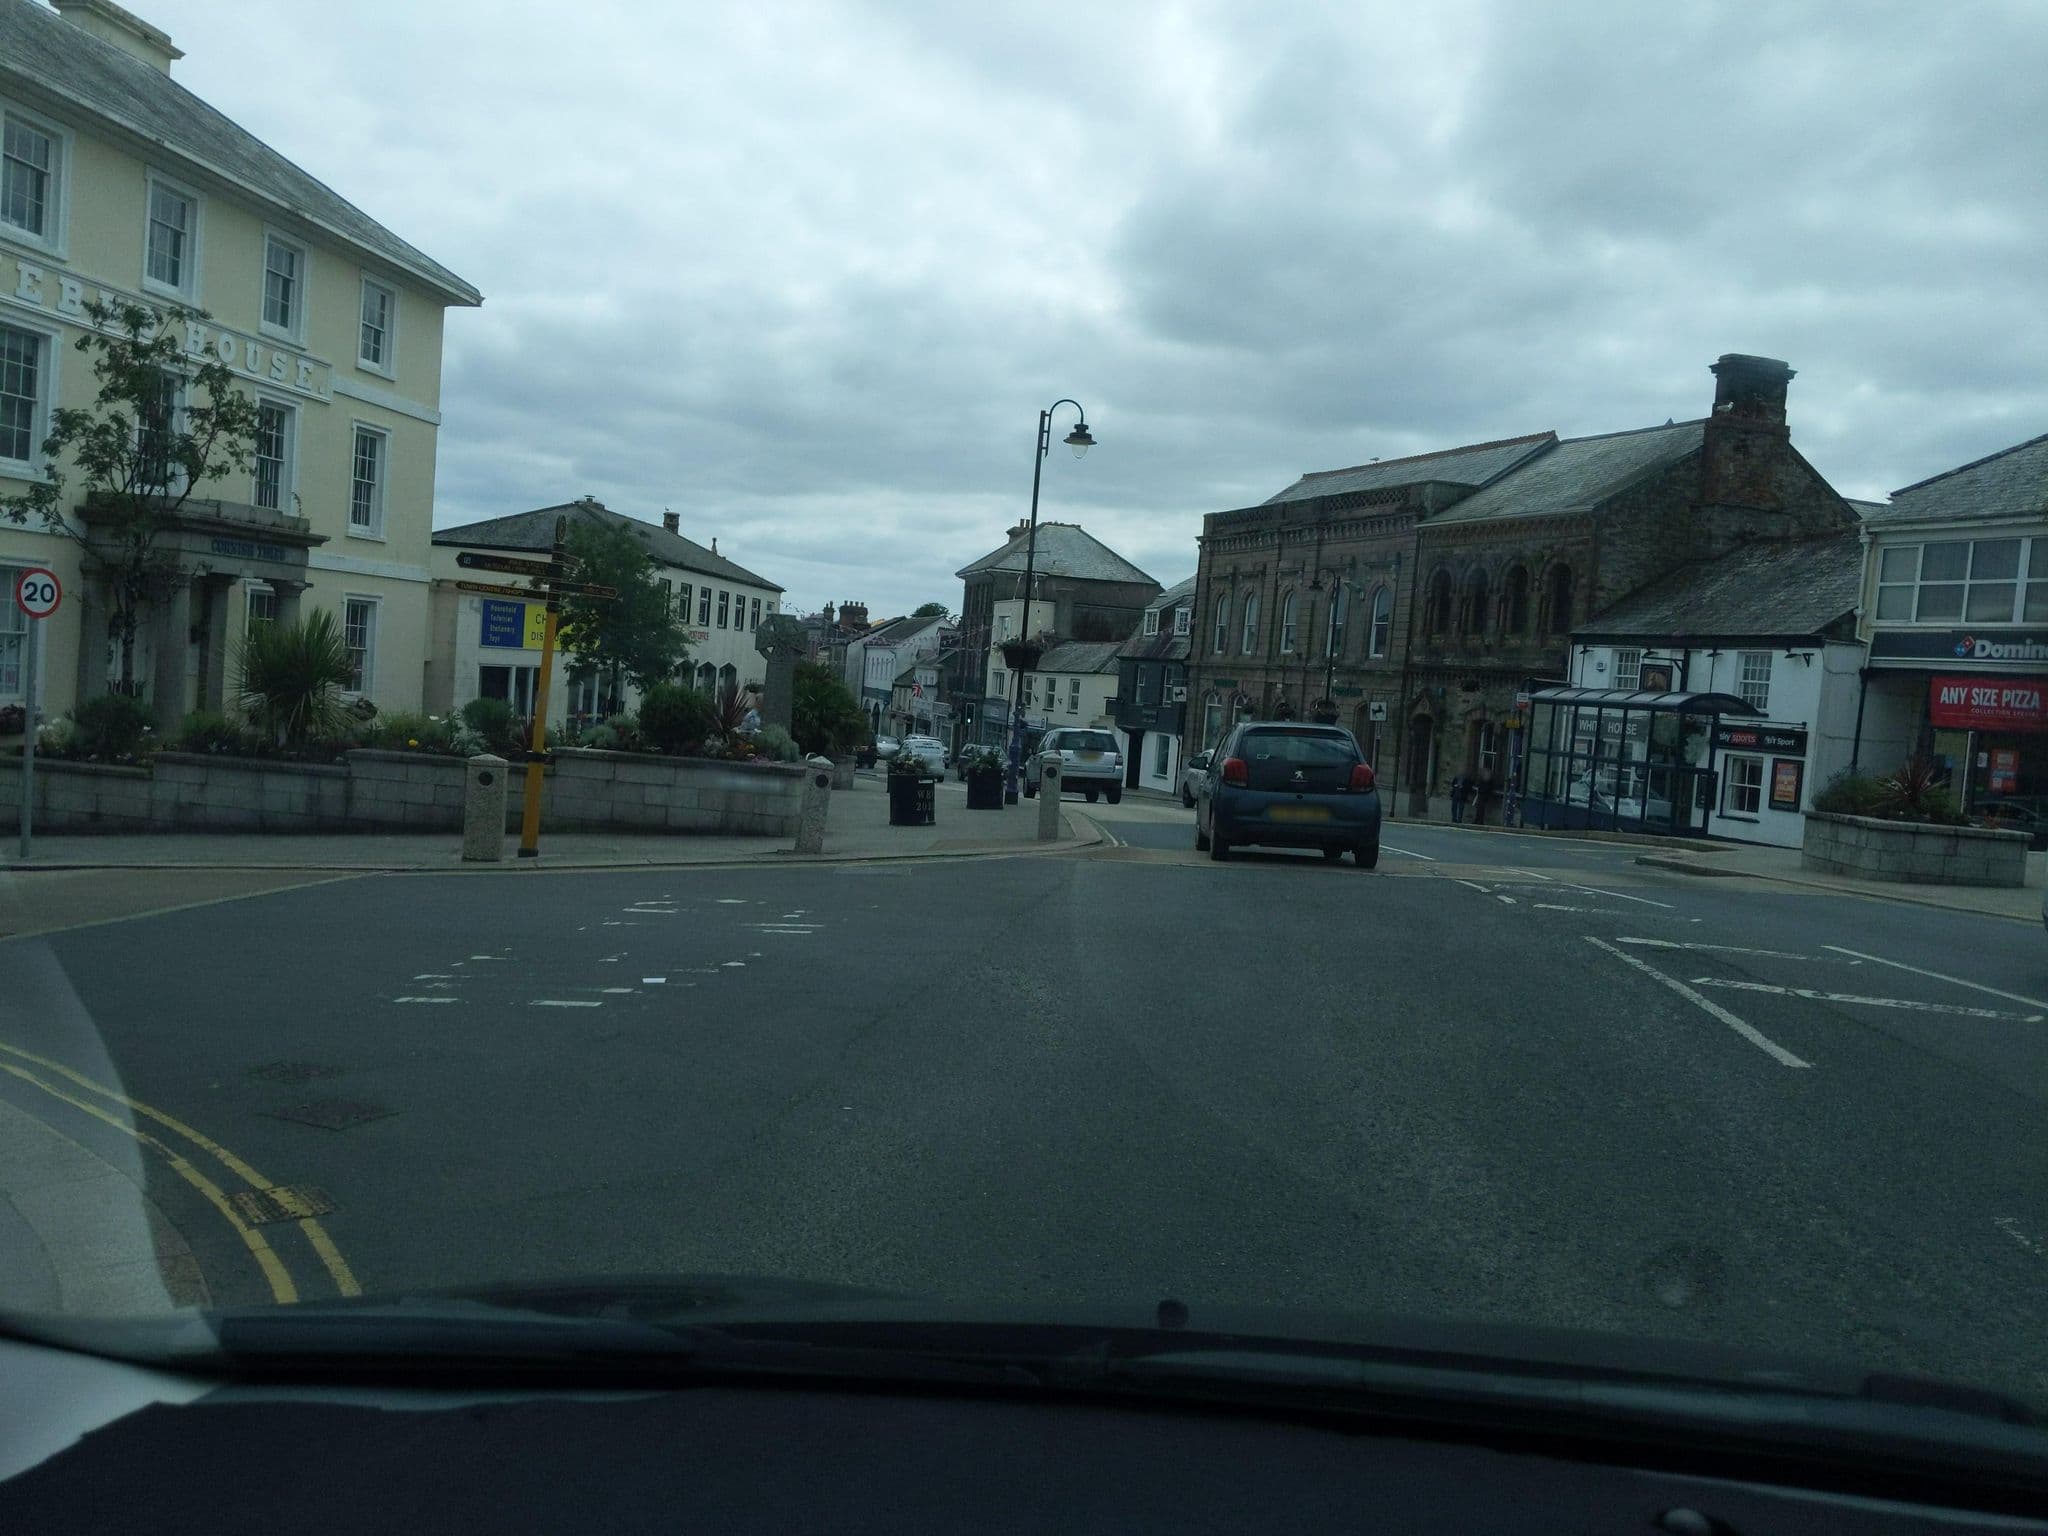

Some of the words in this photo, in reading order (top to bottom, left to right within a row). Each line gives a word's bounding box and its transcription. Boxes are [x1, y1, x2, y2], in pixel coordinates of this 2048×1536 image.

[24, 582, 55, 603] 20
[1974, 638, 2048, 659] Domin
[1940, 687, 1967, 705] ANY
[1971, 688, 1999, 706] SIZE
[2002, 689, 2040, 709] PIZZA
[1732, 735, 1757, 744] sports
